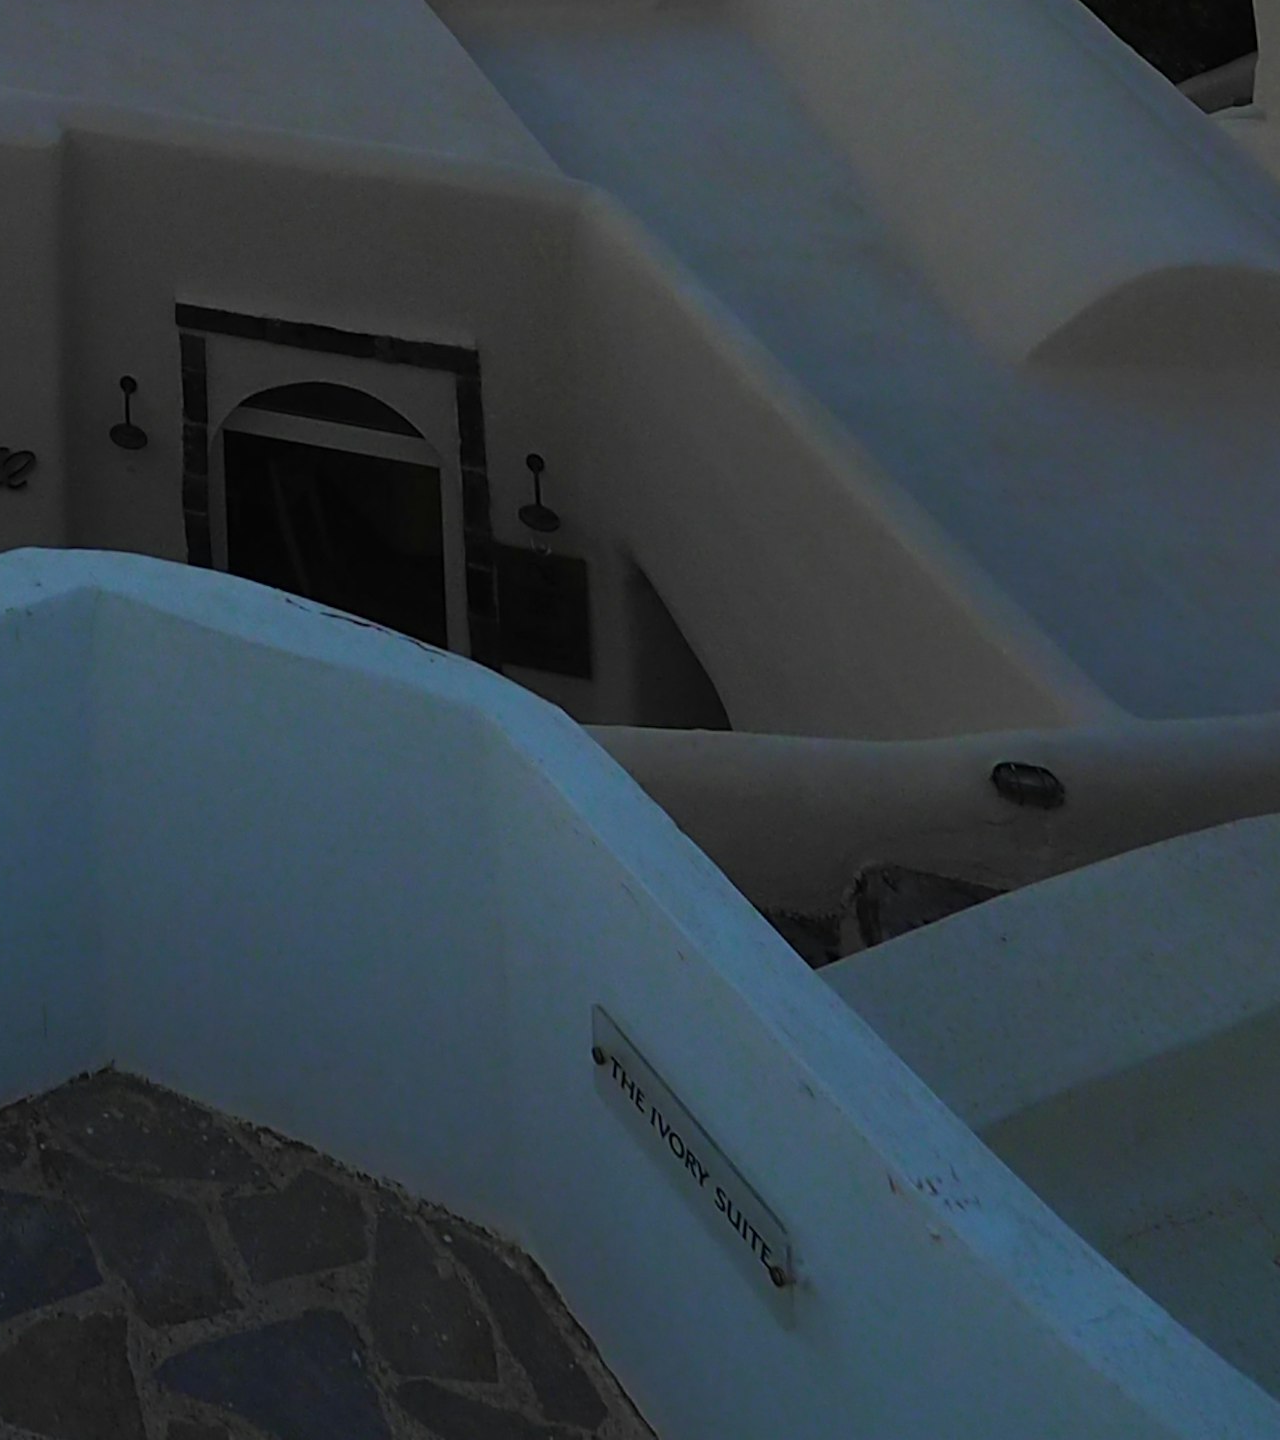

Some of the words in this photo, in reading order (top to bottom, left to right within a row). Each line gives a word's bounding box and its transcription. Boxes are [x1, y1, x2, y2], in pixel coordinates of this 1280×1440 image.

[610, 1056, 645, 1113] THE
[650, 1107, 709, 1187] IVORY
[713, 1187, 773, 1271] SUITE
